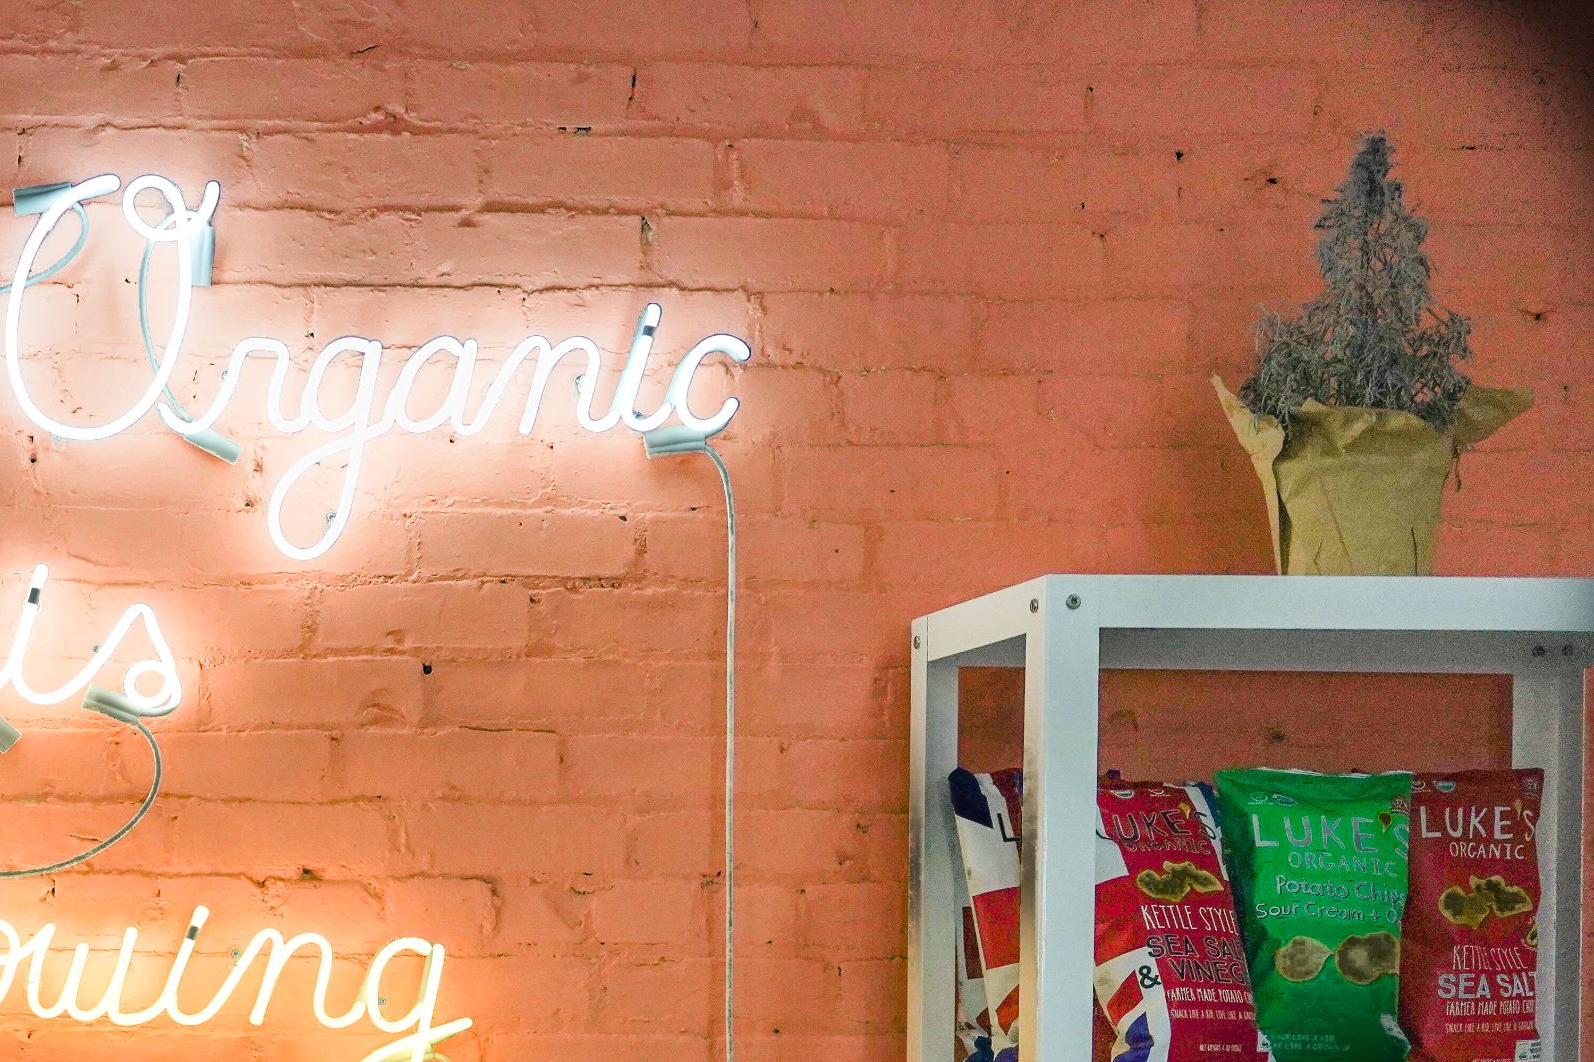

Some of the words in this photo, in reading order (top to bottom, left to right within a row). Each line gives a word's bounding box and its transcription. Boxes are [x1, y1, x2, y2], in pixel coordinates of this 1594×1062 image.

[5, 173, 751, 561] Organic
[1419, 798, 1536, 843] LUKE'S
[1251, 811, 1410, 860] LUKE'S
[1288, 851, 1399, 878] ORGANIC
[1449, 842, 1526, 860] ORGANIC
[1275, 875, 1350, 899] Potato
[1353, 881, 1407, 907] Chips
[1140, 904, 1198, 931] KETTLE
[1199, 905, 1240, 936] STYLE
[1256, 903, 1300, 919] Sour
[1304, 903, 1366, 921] Cream
[1146, 933, 1199, 959] SEA
[1137, 964, 1162, 989] &
[1437, 973, 1491, 999] SEA
[1496, 971, 1537, 998] SALT
[1478, 1000, 1498, 1016] MADE
